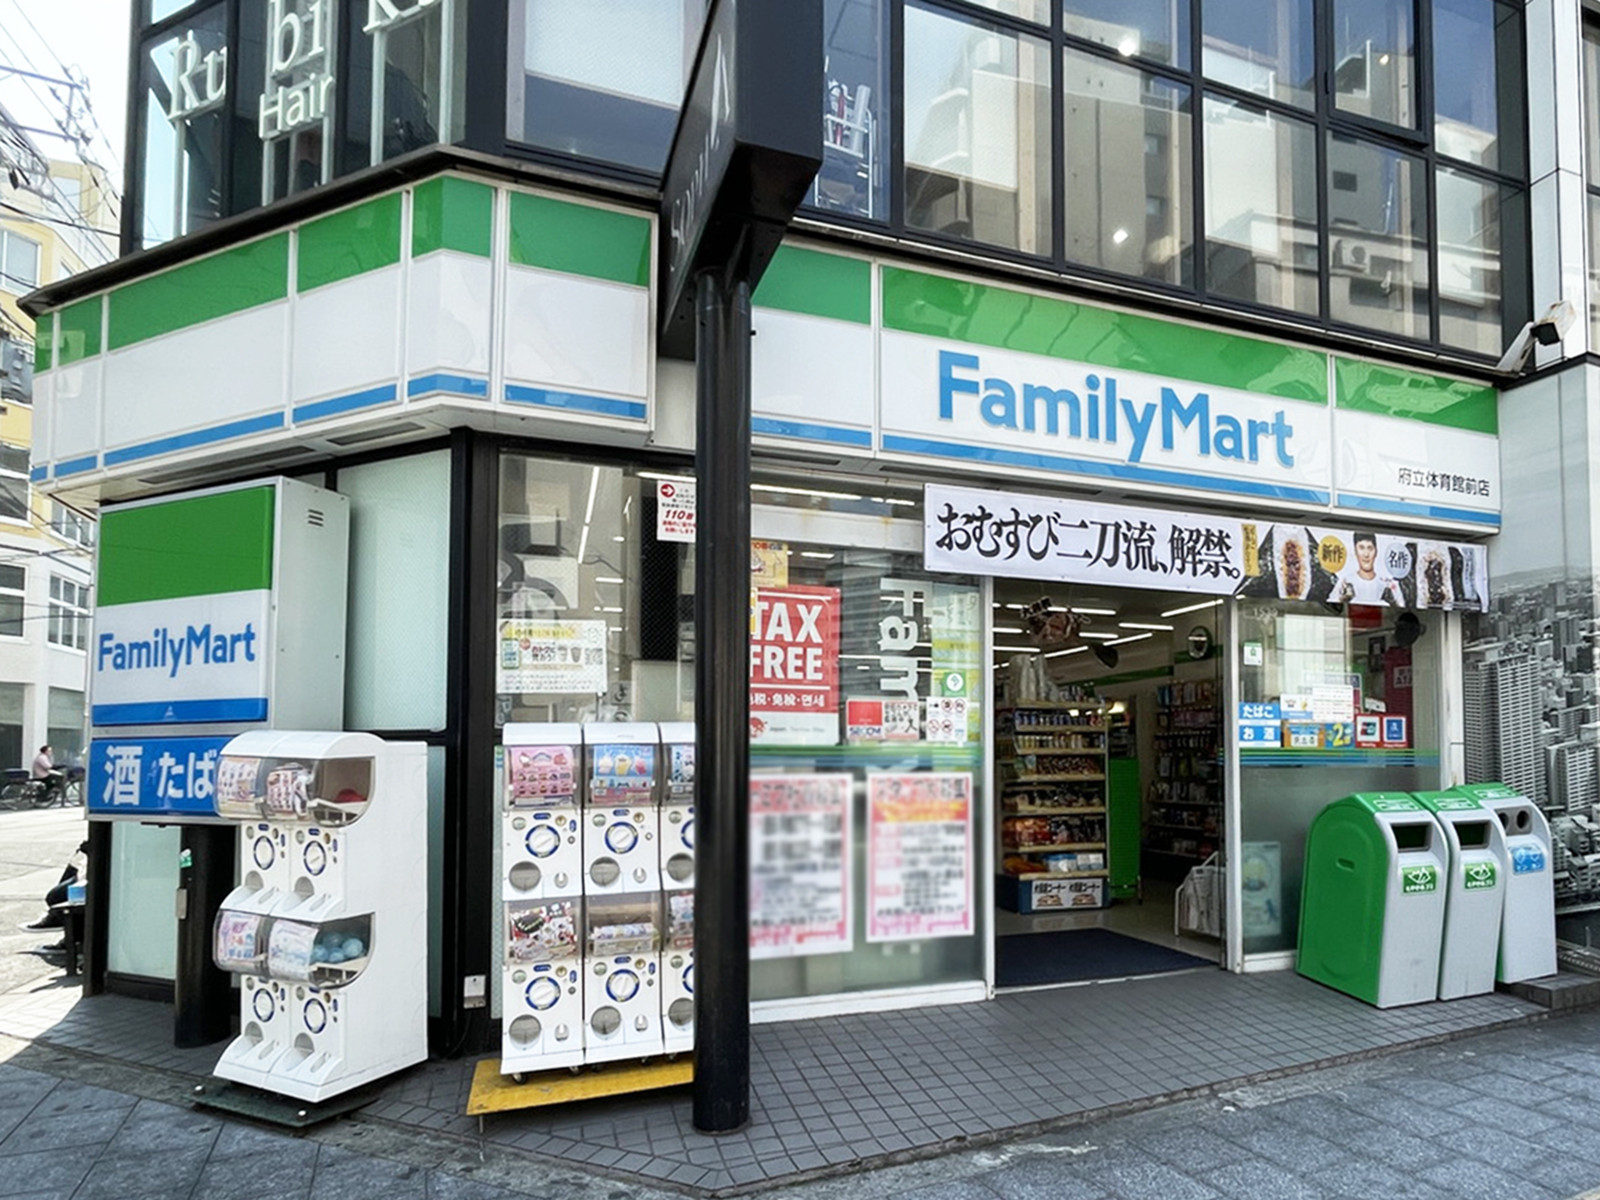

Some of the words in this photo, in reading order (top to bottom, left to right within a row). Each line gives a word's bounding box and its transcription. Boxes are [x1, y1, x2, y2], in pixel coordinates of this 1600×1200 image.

[259, 73, 335, 140] Hair
[938, 350, 1294, 468] FamilyMart
[1398, 467, 1490, 497] 府立体育館前店
[935, 502, 1241, 580] おむすび二刀流、解禁。
[1322, 542, 1345, 563] 新作
[1389, 549, 1409, 569] 名作
[751, 601, 823, 643] TAX
[98, 623, 255, 678] FamilyMart
[750, 645, 823, 680] FREE
[1242, 705, 1275, 719] たばこ
[103, 745, 143, 806] 酒
